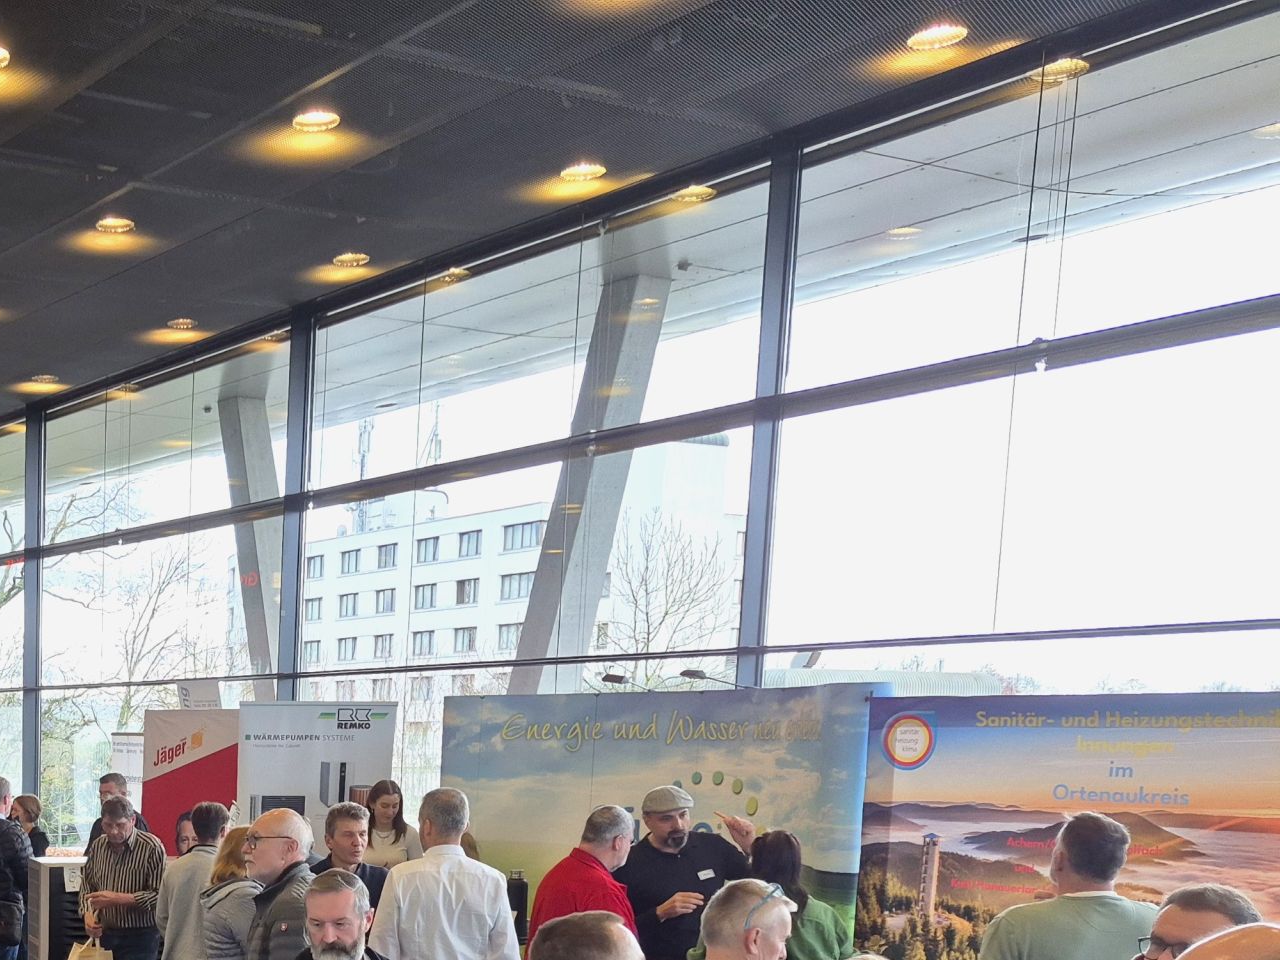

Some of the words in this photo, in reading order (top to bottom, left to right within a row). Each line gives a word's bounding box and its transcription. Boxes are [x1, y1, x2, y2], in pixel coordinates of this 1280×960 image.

[975, 711, 1055, 728] Sanitär-
[1061, 711, 1099, 728] und
[253, 732, 320, 741] WÄRMEPUMPEN
[502, 713, 604, 752] Energie
[614, 714, 658, 740] und
[666, 710, 750, 745] Wasser
[153, 740, 187, 767] Jäger
[1109, 761, 1134, 778] im
[1052, 784, 1191, 806] Ortenaukreis
